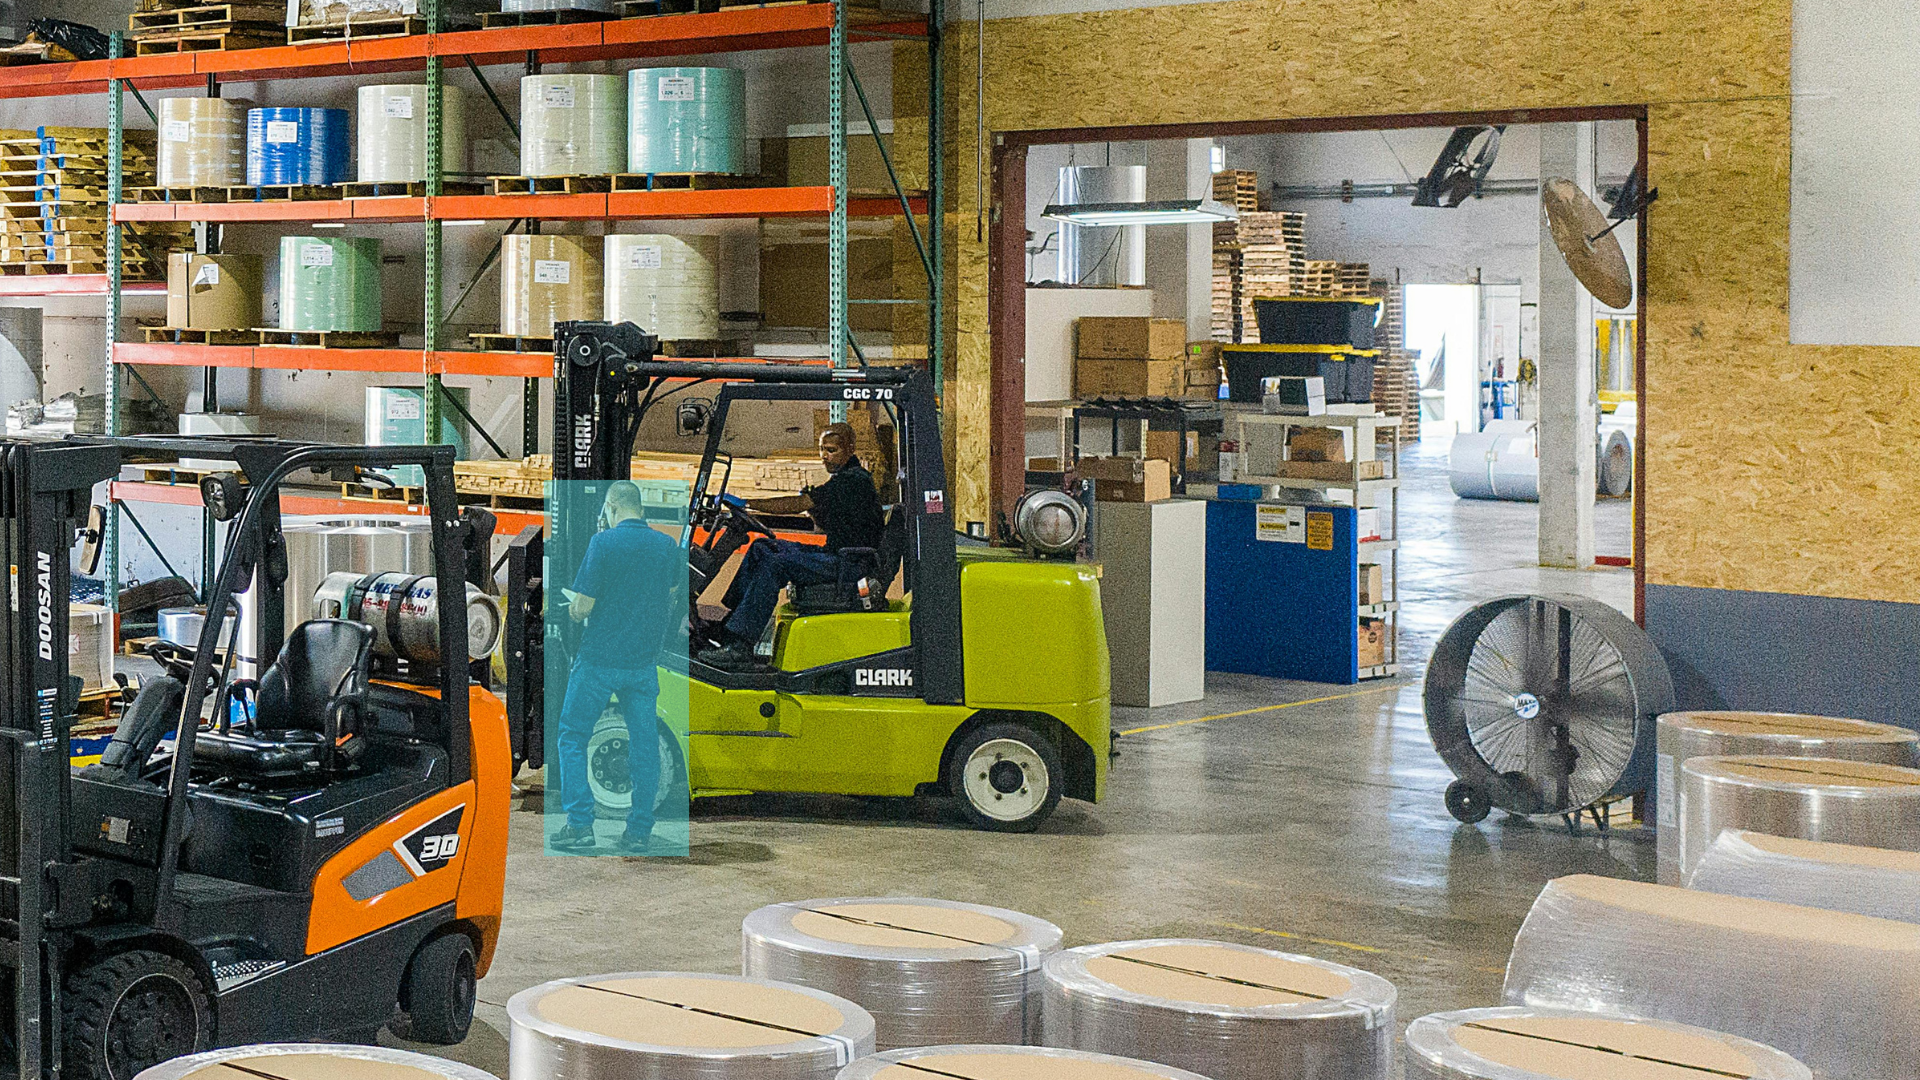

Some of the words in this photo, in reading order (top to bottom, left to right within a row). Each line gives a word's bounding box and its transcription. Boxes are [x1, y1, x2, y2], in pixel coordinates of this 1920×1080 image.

[843, 388, 871, 400] CGC
[875, 388, 893, 400] 70
[574, 414, 592, 468] CLARK
[37, 551, 53, 661] DOOSAN
[855, 668, 913, 687] CLARK
[419, 833, 461, 862] 30
